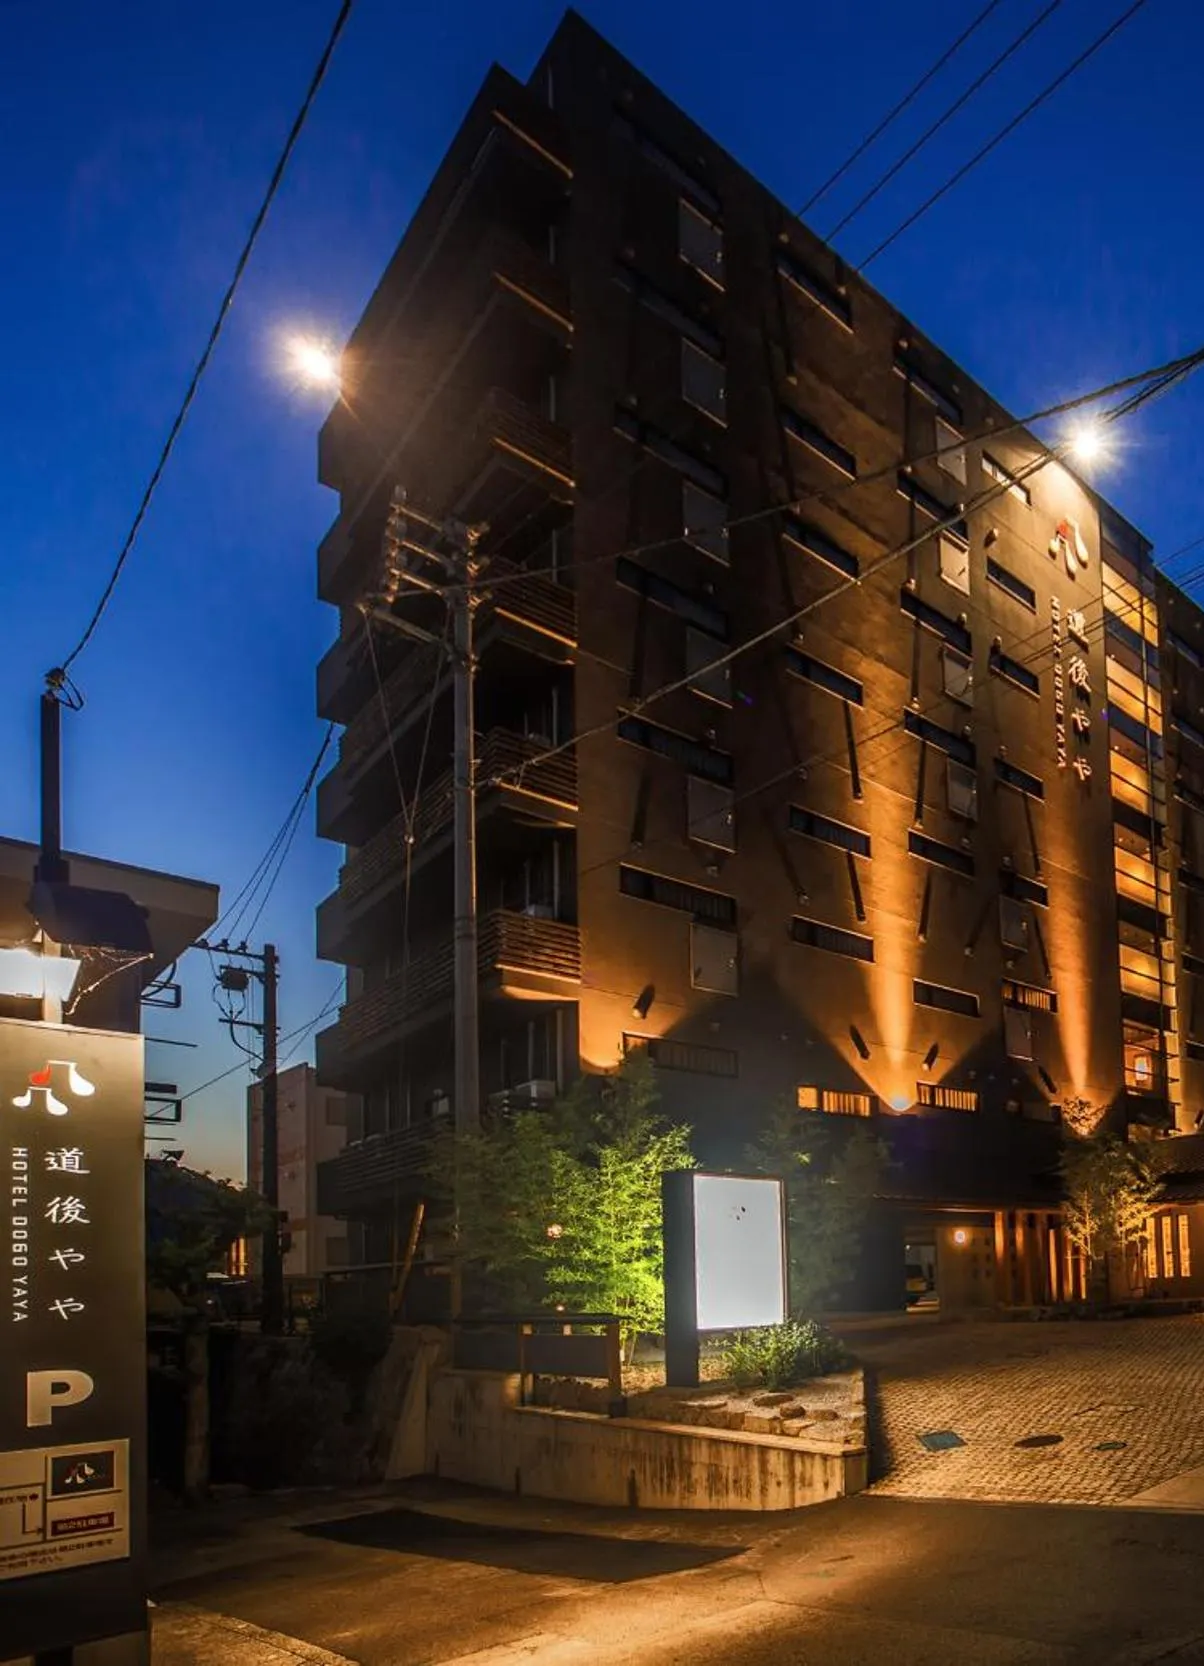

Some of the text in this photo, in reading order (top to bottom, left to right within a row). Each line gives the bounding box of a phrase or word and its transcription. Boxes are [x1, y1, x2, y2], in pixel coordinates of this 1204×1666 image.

[12, 1147, 28, 1321] HOTEL DOGO YAYA
[44, 1147, 91, 1320] 道後やや
[27, 1370, 94, 1427] P
